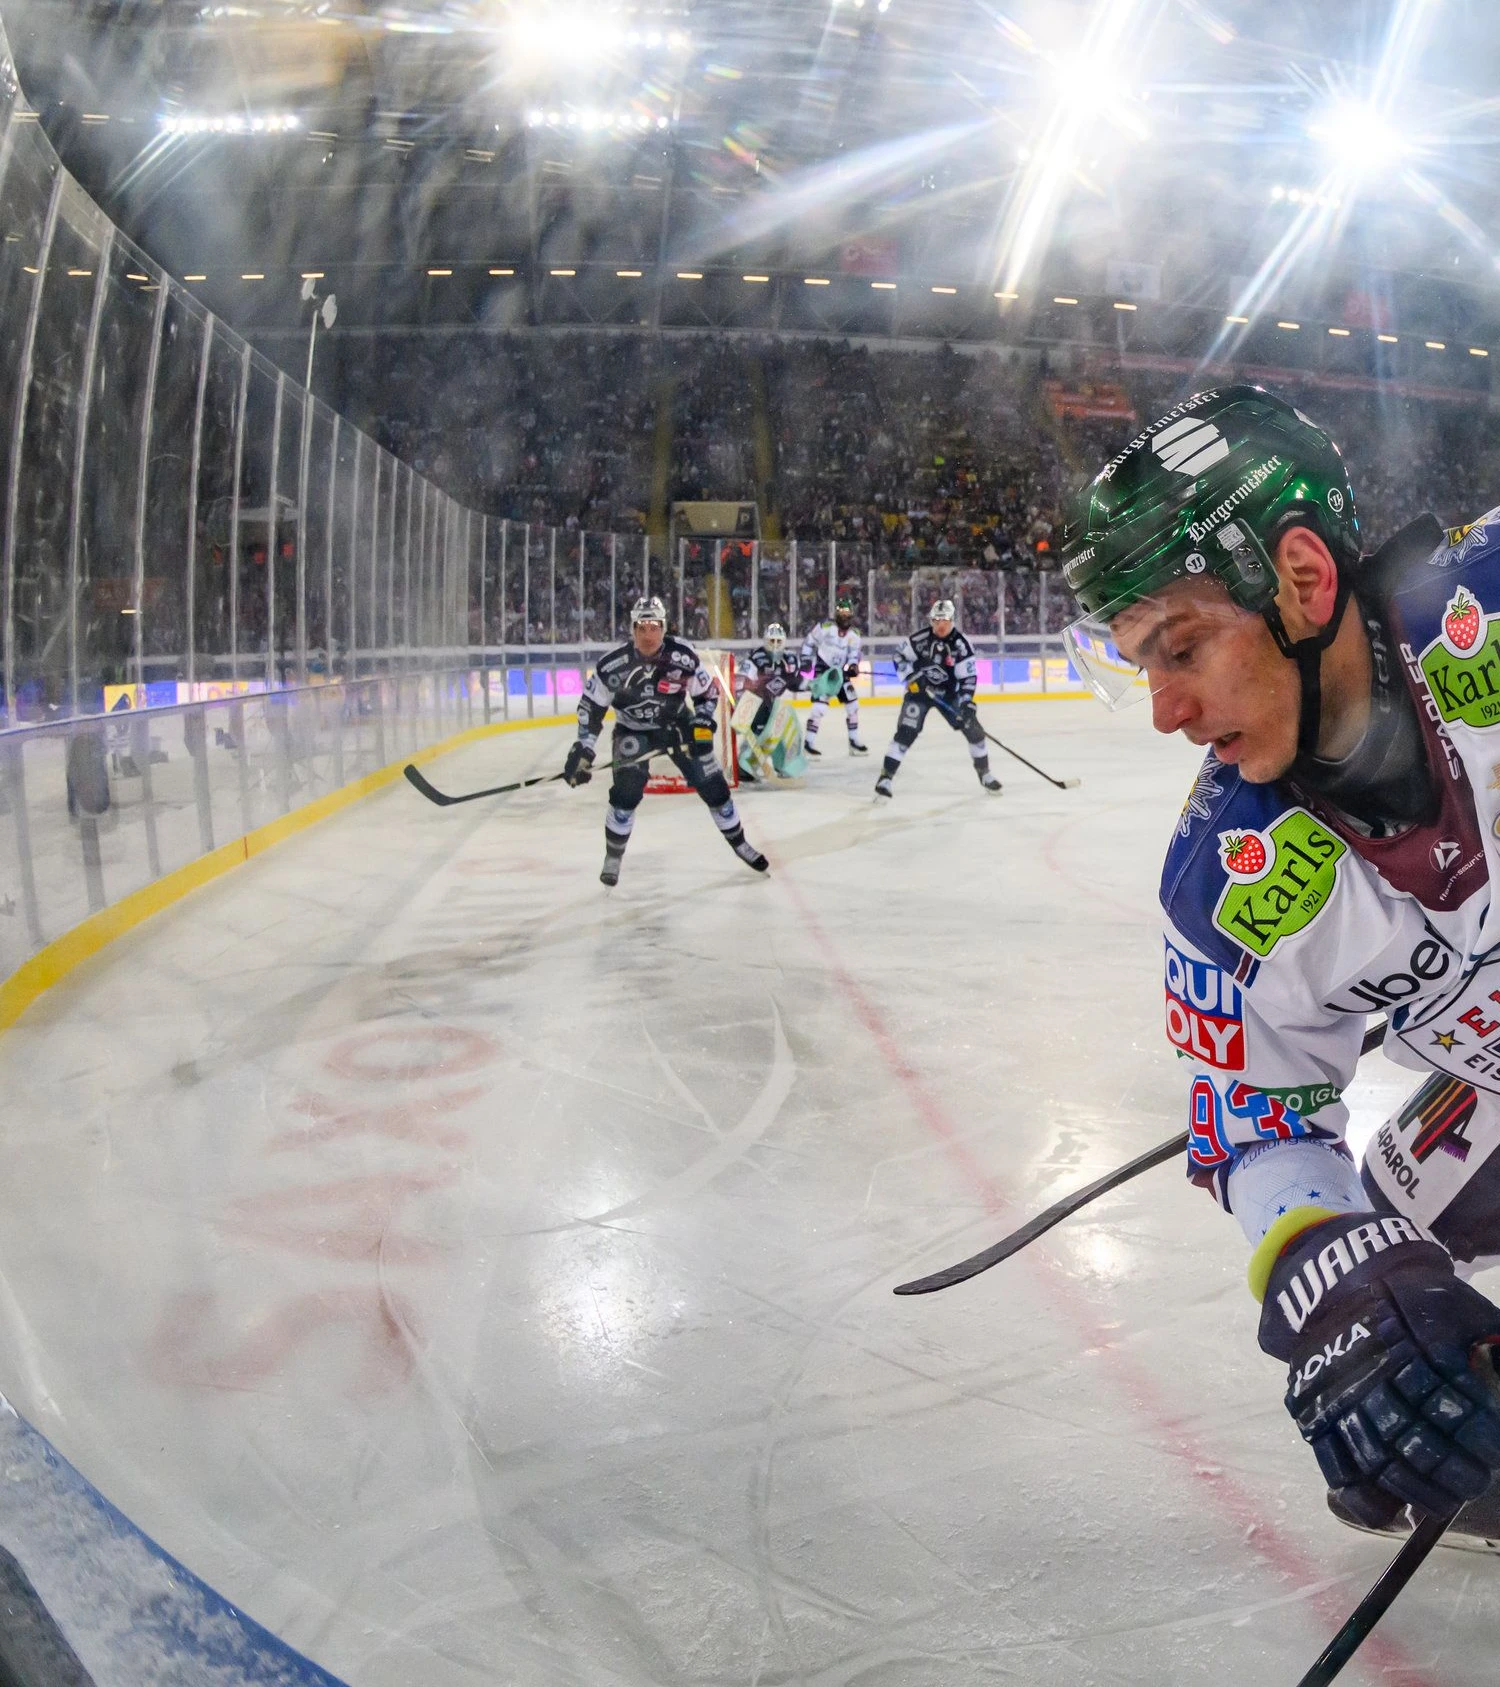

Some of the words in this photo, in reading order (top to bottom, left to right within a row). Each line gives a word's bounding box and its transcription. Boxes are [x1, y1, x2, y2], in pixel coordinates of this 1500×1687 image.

[1102, 389, 1220, 482] Burgermeister
[1185, 455, 1283, 545] Burgermeister
[1231, 826, 1336, 947] Karls
[1300, 889, 1322, 914] 1921
